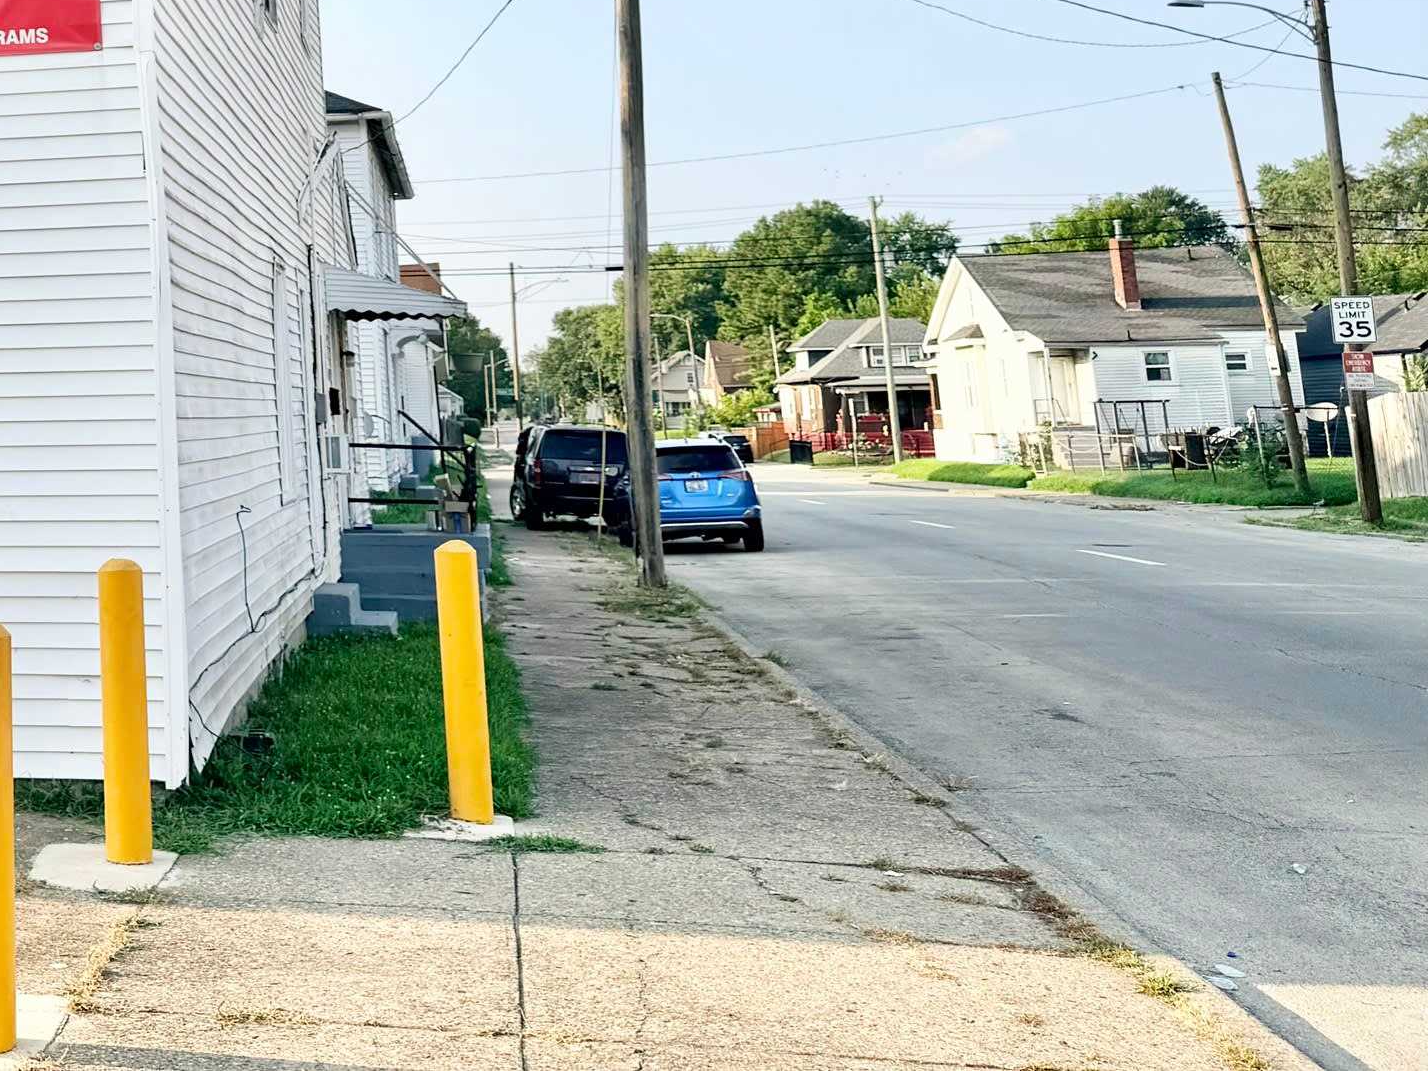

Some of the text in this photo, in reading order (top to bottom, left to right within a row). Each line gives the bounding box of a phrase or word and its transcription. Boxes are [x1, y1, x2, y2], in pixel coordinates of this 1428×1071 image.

[1334, 301, 1370, 309] SPEED
[1338, 311, 1367, 319] LIMIT
[1339, 321, 1372, 338] 35
